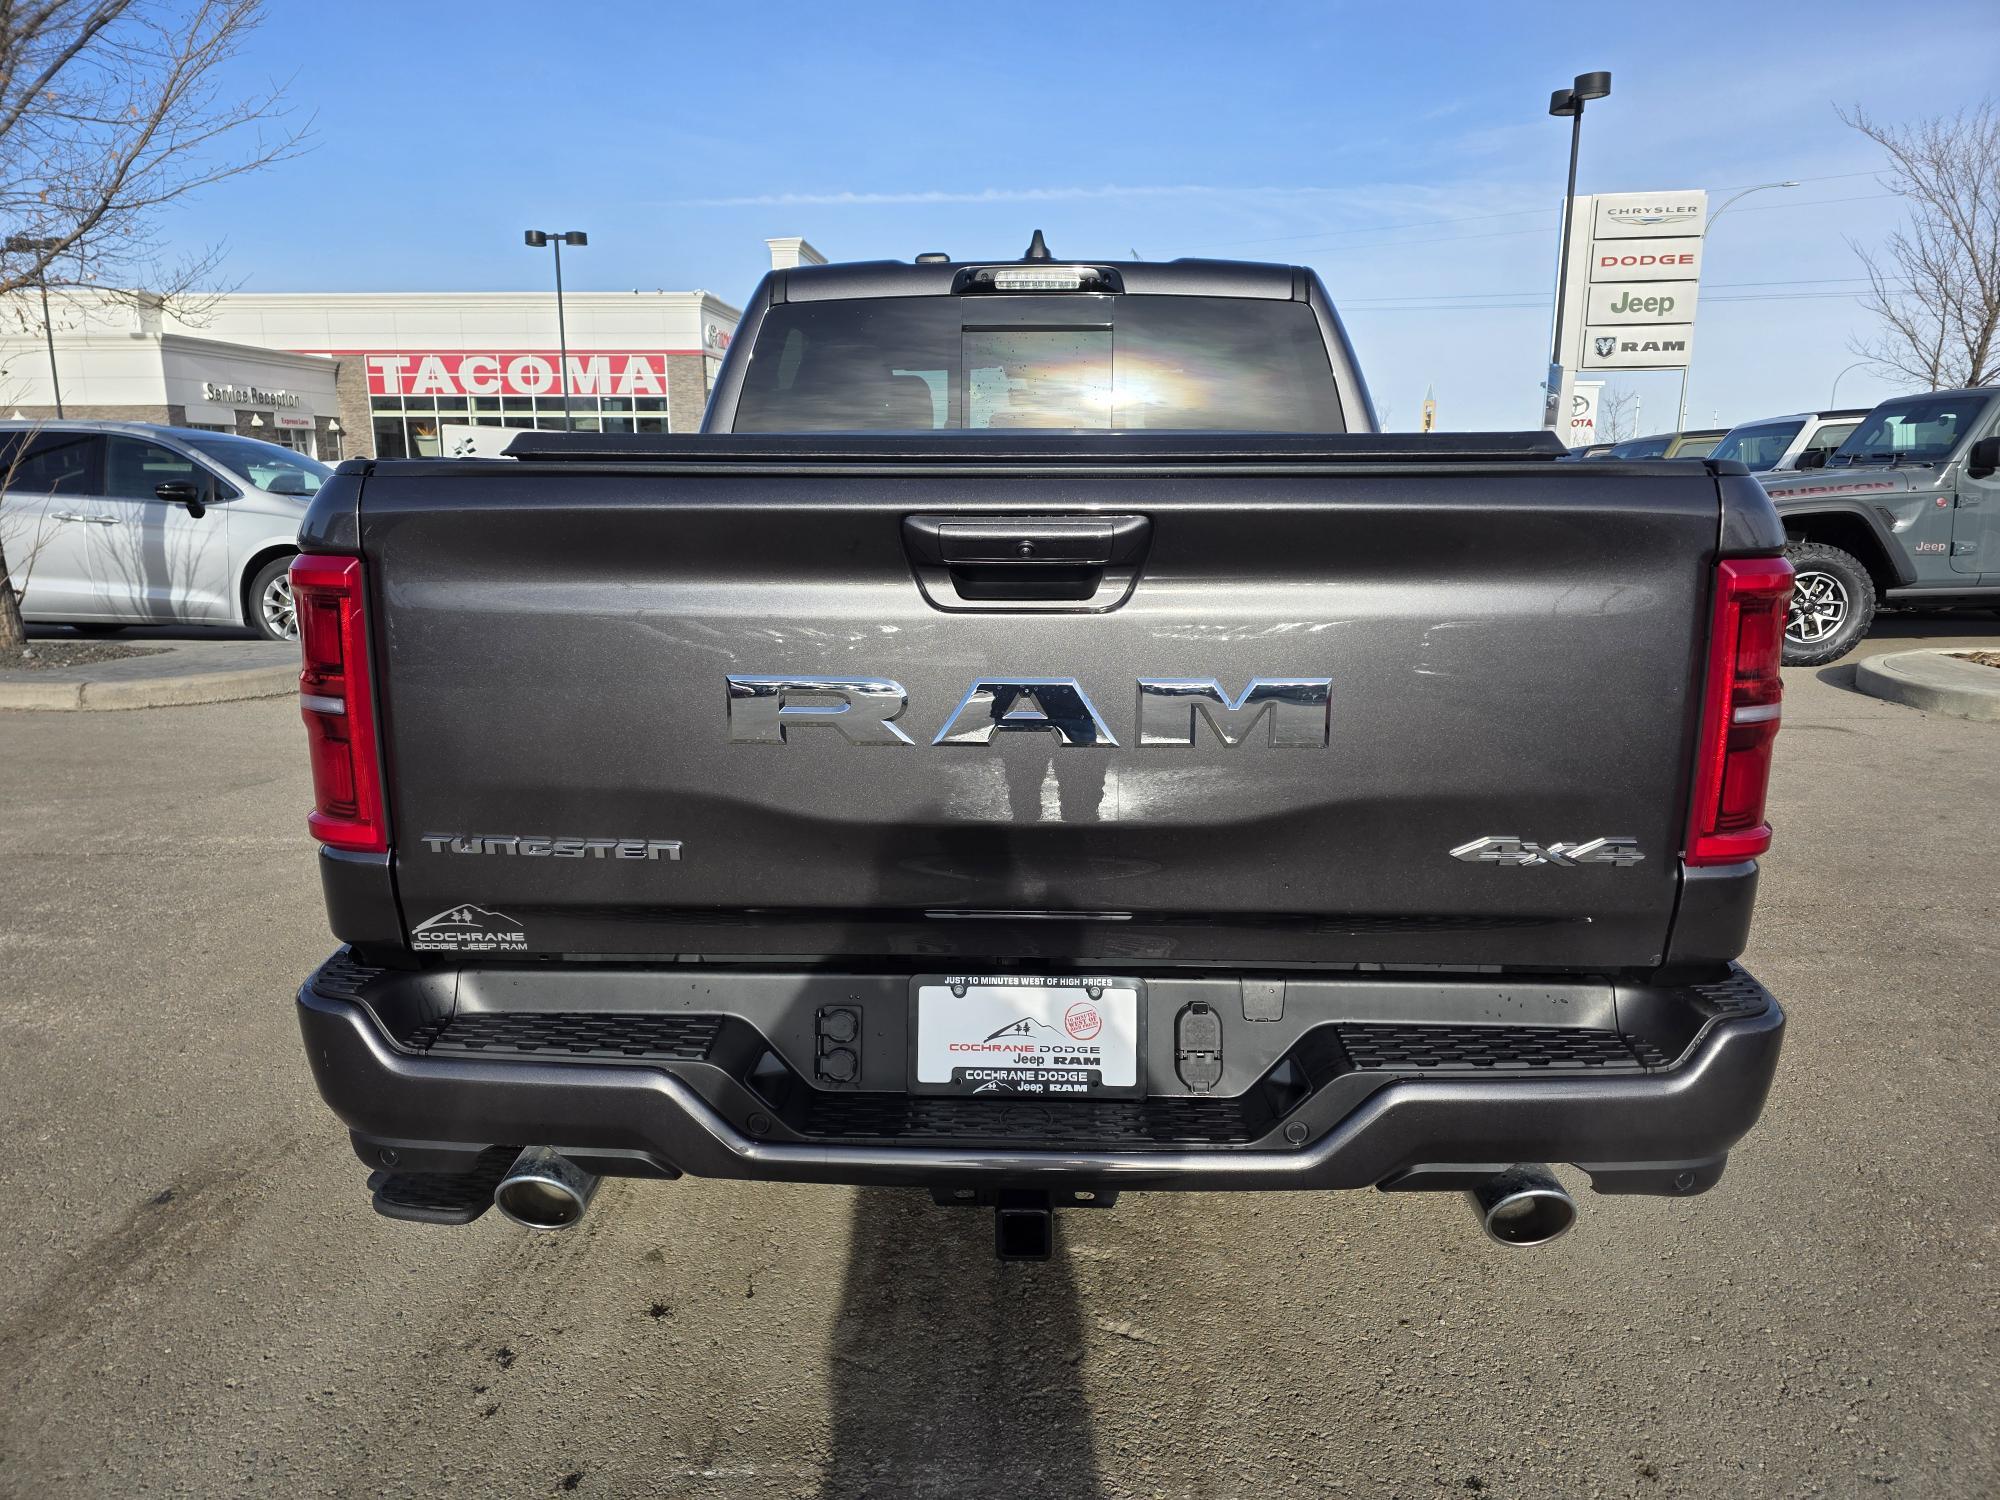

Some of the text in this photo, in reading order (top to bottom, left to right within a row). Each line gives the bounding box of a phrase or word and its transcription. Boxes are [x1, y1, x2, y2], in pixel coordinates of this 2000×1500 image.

[1607, 206, 1698, 215] CHRYSLER
[1600, 254, 1694, 267] DODGE
[1610, 291, 1675, 316] Jeep
[1620, 341, 1685, 352] RAM
[368, 356, 664, 395] TACOMA
[203, 382, 300, 410] Service Reception
[1768, 482, 1894, 497] RUBICON
[1915, 541, 1946, 552] Jeep
[725, 674, 1333, 749] RAM
[417, 932, 525, 942] COCHRANE
[413, 943, 528, 951] DODGE JEEP RAM
[944, 976, 1113, 987] JUST 10 MINUTES WEST OF HIGH PRICES
[949, 1043, 1100, 1054] COCHRANE DODGE
[1013, 1053, 1101, 1067] Jeep RAM
[965, 1070, 1088, 1082] COCHRANE DODGE
[1017, 1081, 1088, 1093] Jeep RAM
